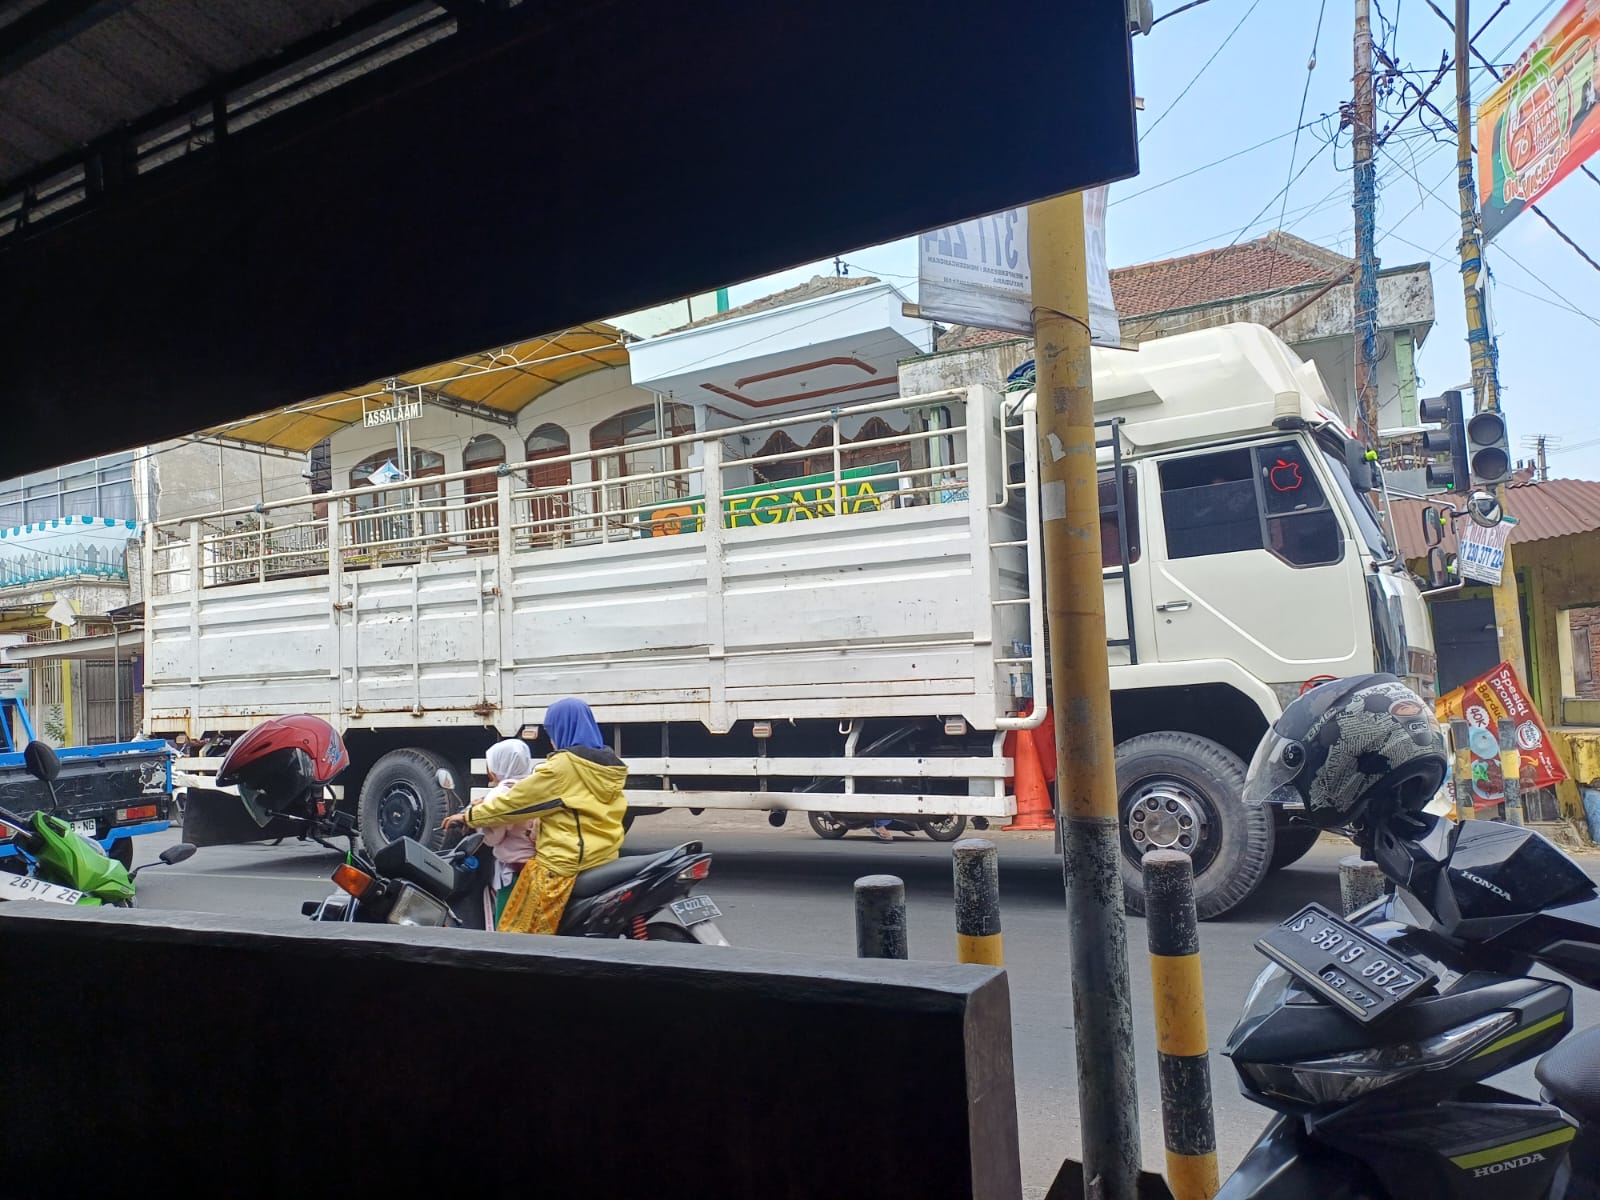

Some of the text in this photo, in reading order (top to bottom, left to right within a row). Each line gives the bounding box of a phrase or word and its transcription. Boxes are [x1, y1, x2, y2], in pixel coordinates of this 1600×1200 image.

[367, 404, 419, 426] ASSALAAM
[1491, 678, 1517, 716] promo
[1500, 669, 1529, 716] Spesial
[1470, 707, 1487, 728] 40K
[82, 820, 95, 831] NG
[9, 876, 80, 904] 2617 ZE
[1460, 870, 1512, 901] HONDA
[1291, 916, 1314, 933] S
[1310, 926, 1365, 963] 5819
[1473, 1152, 1547, 1178] HONDA
